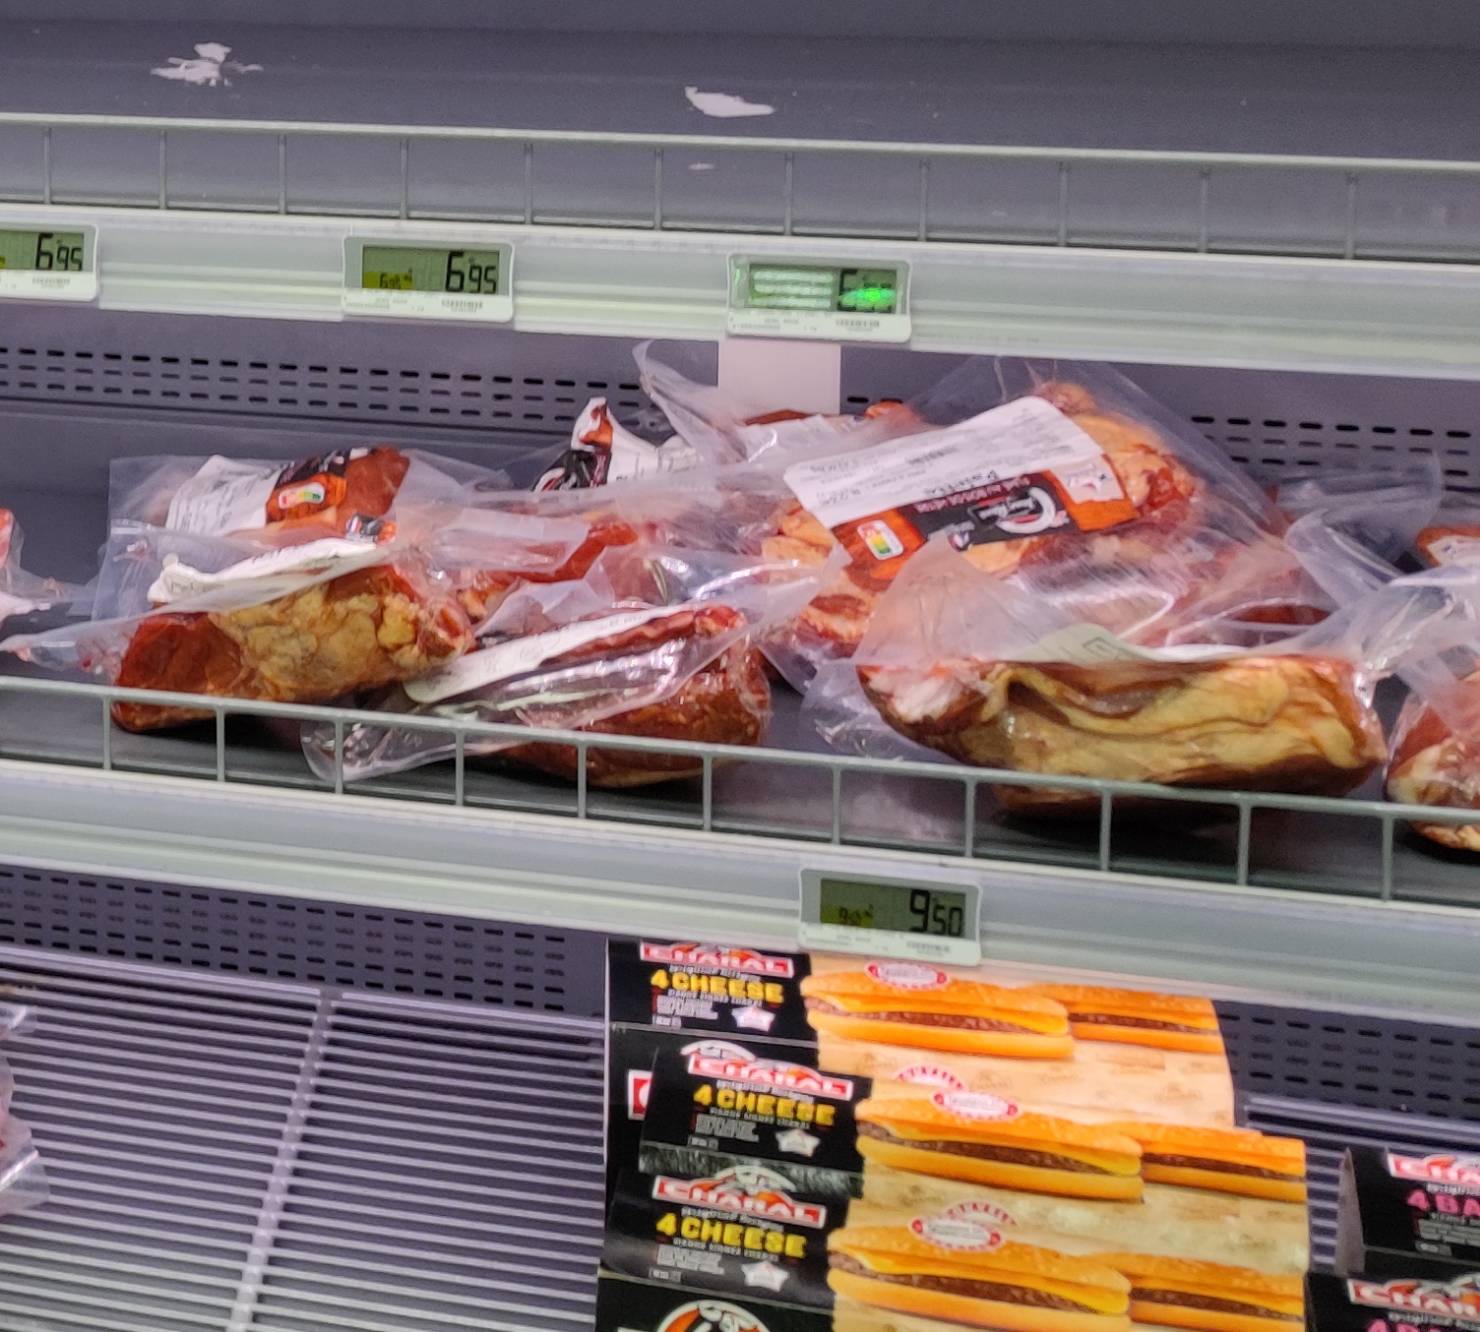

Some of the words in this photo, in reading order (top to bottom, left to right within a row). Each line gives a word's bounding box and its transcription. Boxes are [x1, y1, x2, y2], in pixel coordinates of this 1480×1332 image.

[648, 946, 787, 974] CHARAL
[651, 969, 670, 991] 4
[672, 971, 784, 1003] CHEESE
[698, 1060, 850, 1099] CHARAL
[693, 1083, 714, 1107] 4
[715, 1088, 836, 1127] CHEESE
[661, 1181, 820, 1223] CHARAL
[656, 1212, 678, 1236] 4
[680, 1216, 807, 1259] CHEESE
